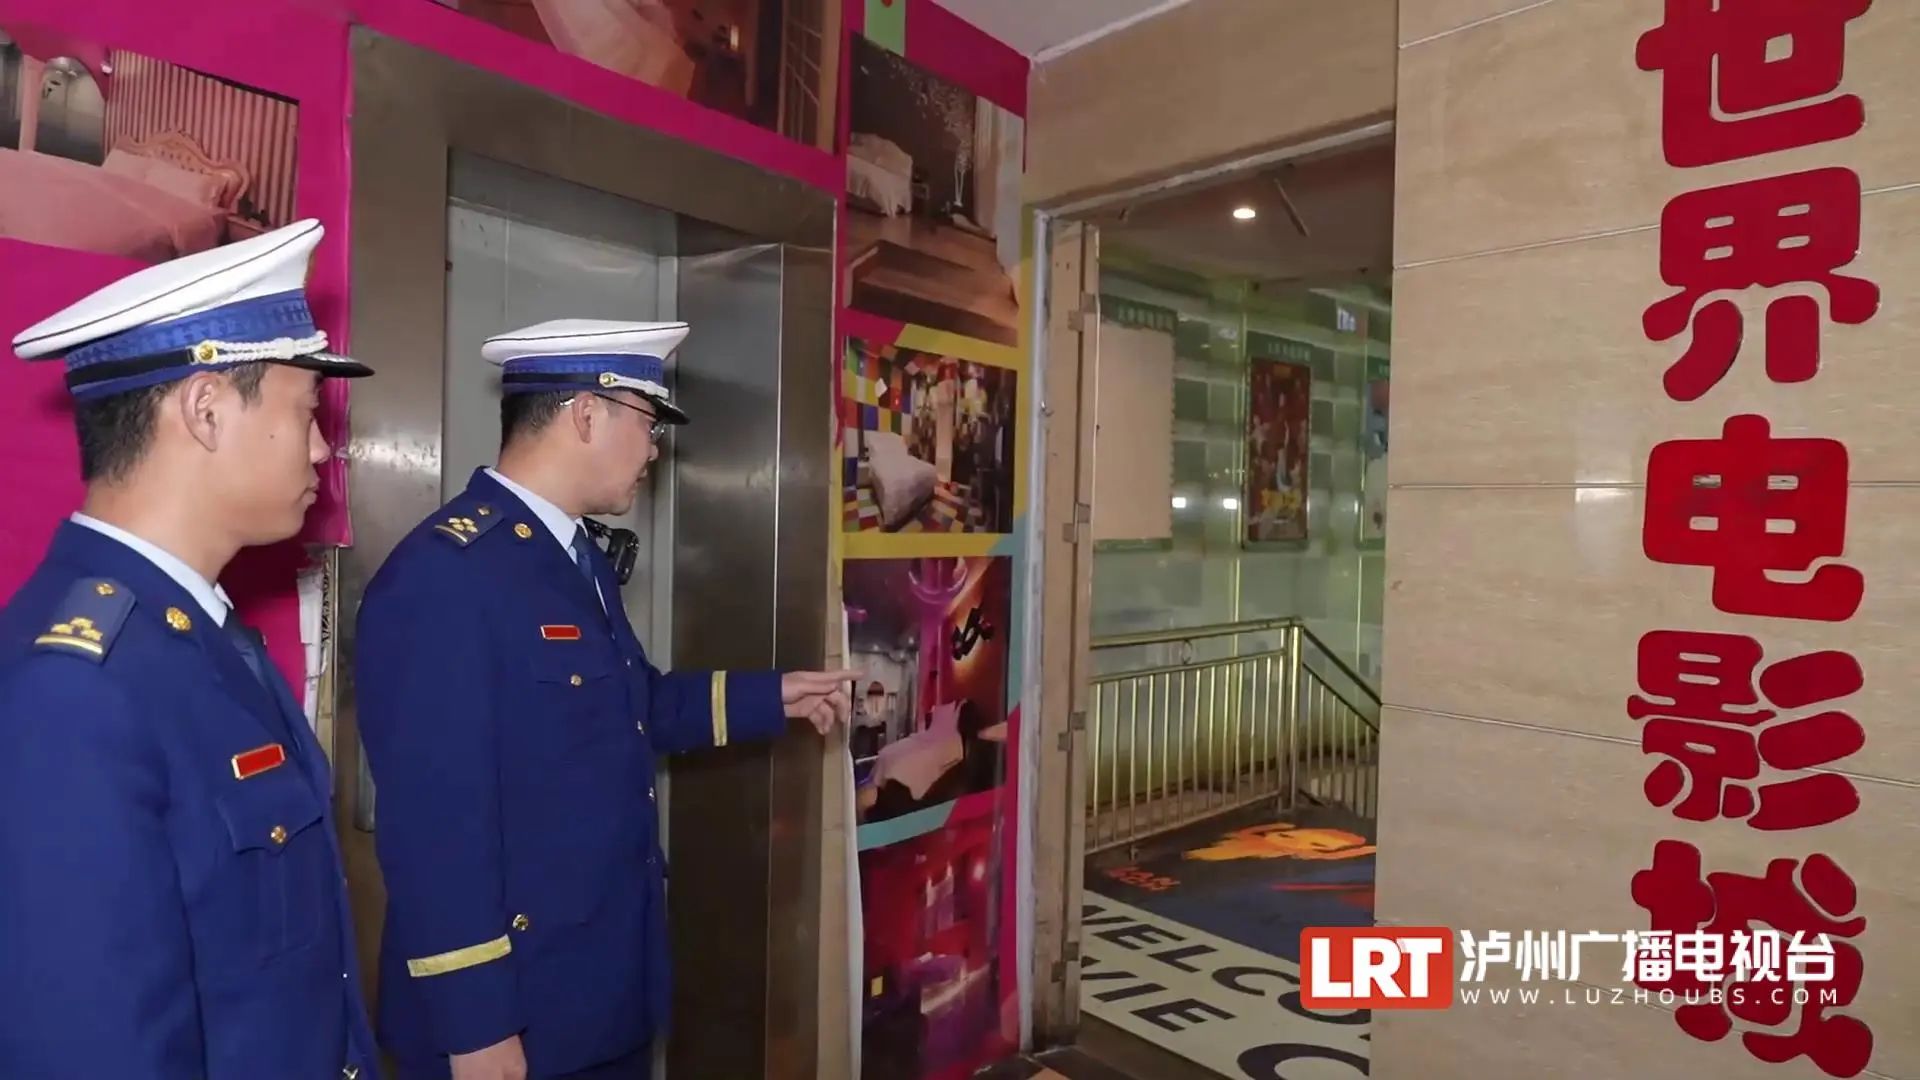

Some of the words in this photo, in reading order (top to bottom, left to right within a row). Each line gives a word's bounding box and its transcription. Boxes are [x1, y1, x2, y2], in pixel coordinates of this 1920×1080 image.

[1627, 0, 1880, 1078] 世界电影城
